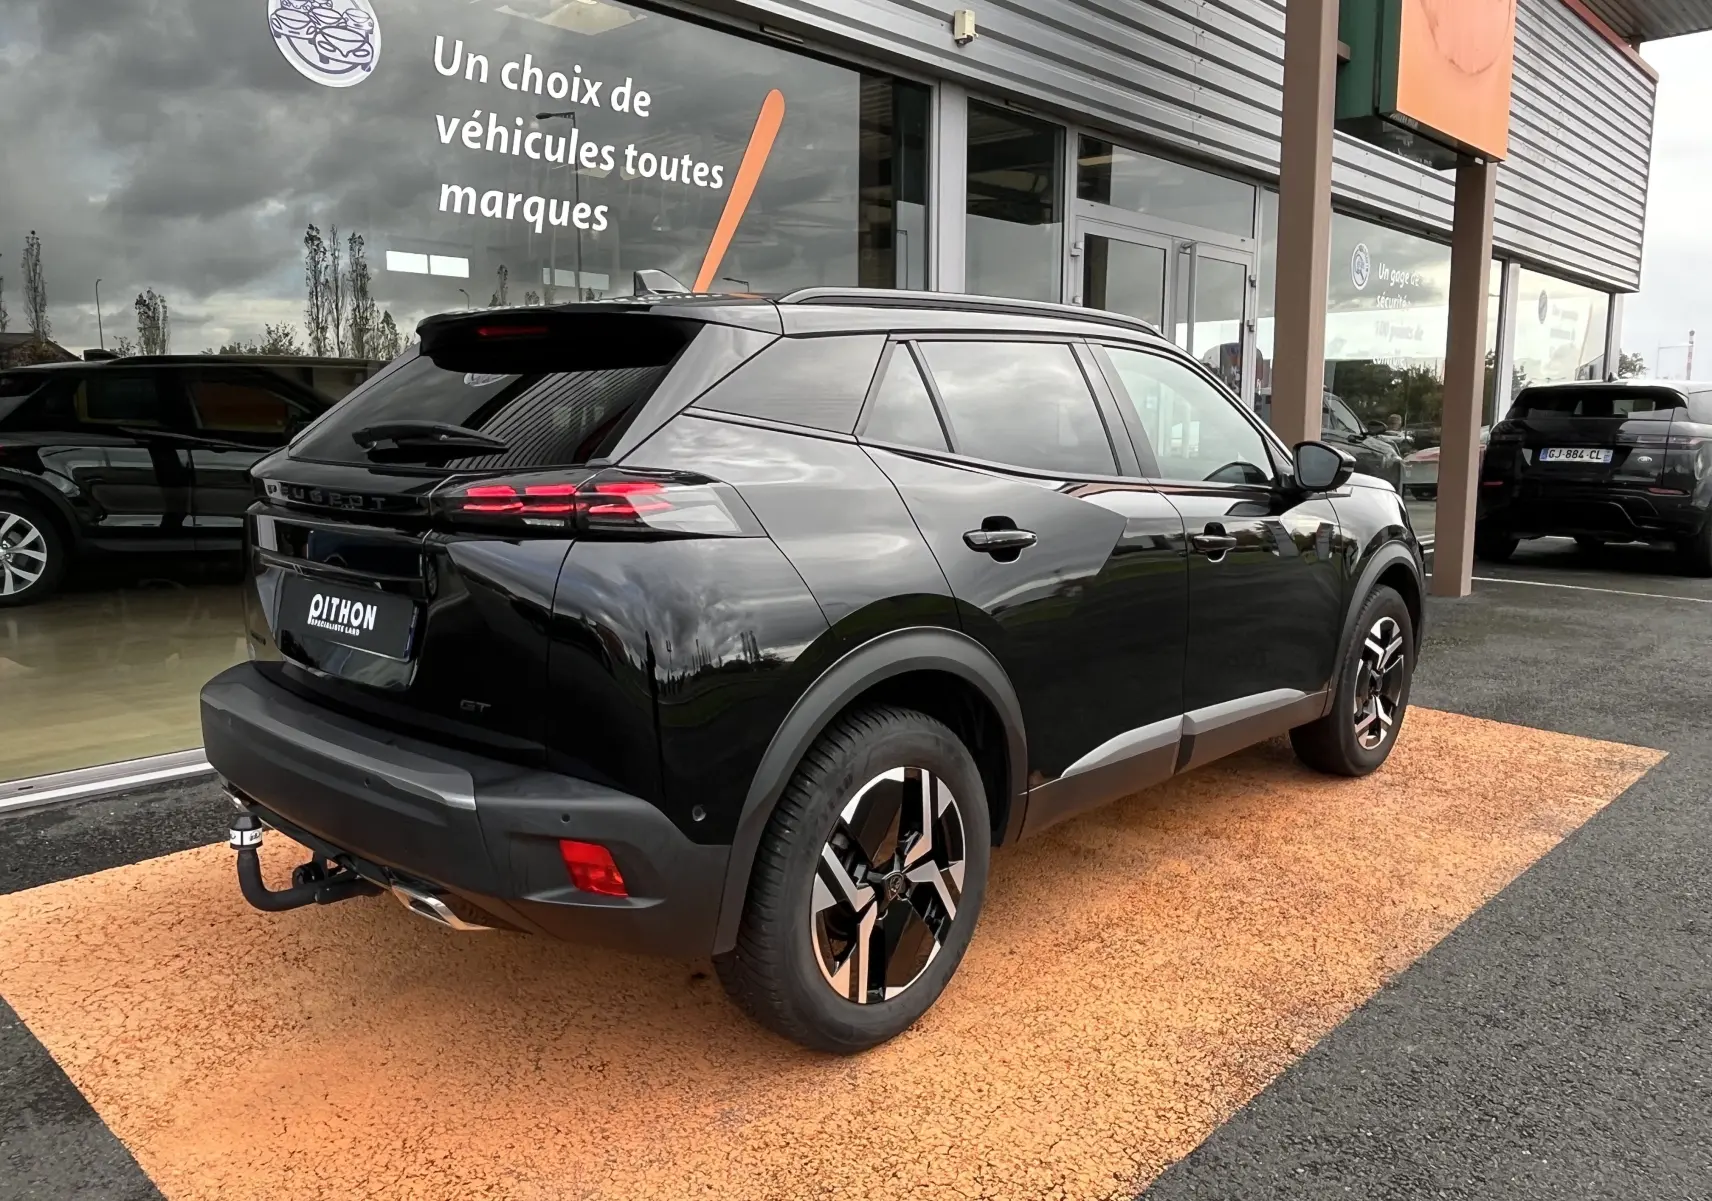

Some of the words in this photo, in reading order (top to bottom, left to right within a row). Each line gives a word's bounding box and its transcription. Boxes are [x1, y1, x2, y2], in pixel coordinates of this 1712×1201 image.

[433, 36, 488, 83] Un
[500, 53, 603, 108] choix
[610, 76, 652, 118] de
[435, 108, 616, 172] véhicules
[624, 143, 725, 189] toutes
[438, 183, 609, 234] marques
[1378, 263, 1389, 280] Un
[1390, 269, 1409, 288] gage
[1548, 449, 1602, 460] GJ-884-CL
[307, 593, 378, 631] PITHON
[460, 699, 492, 713] GT
